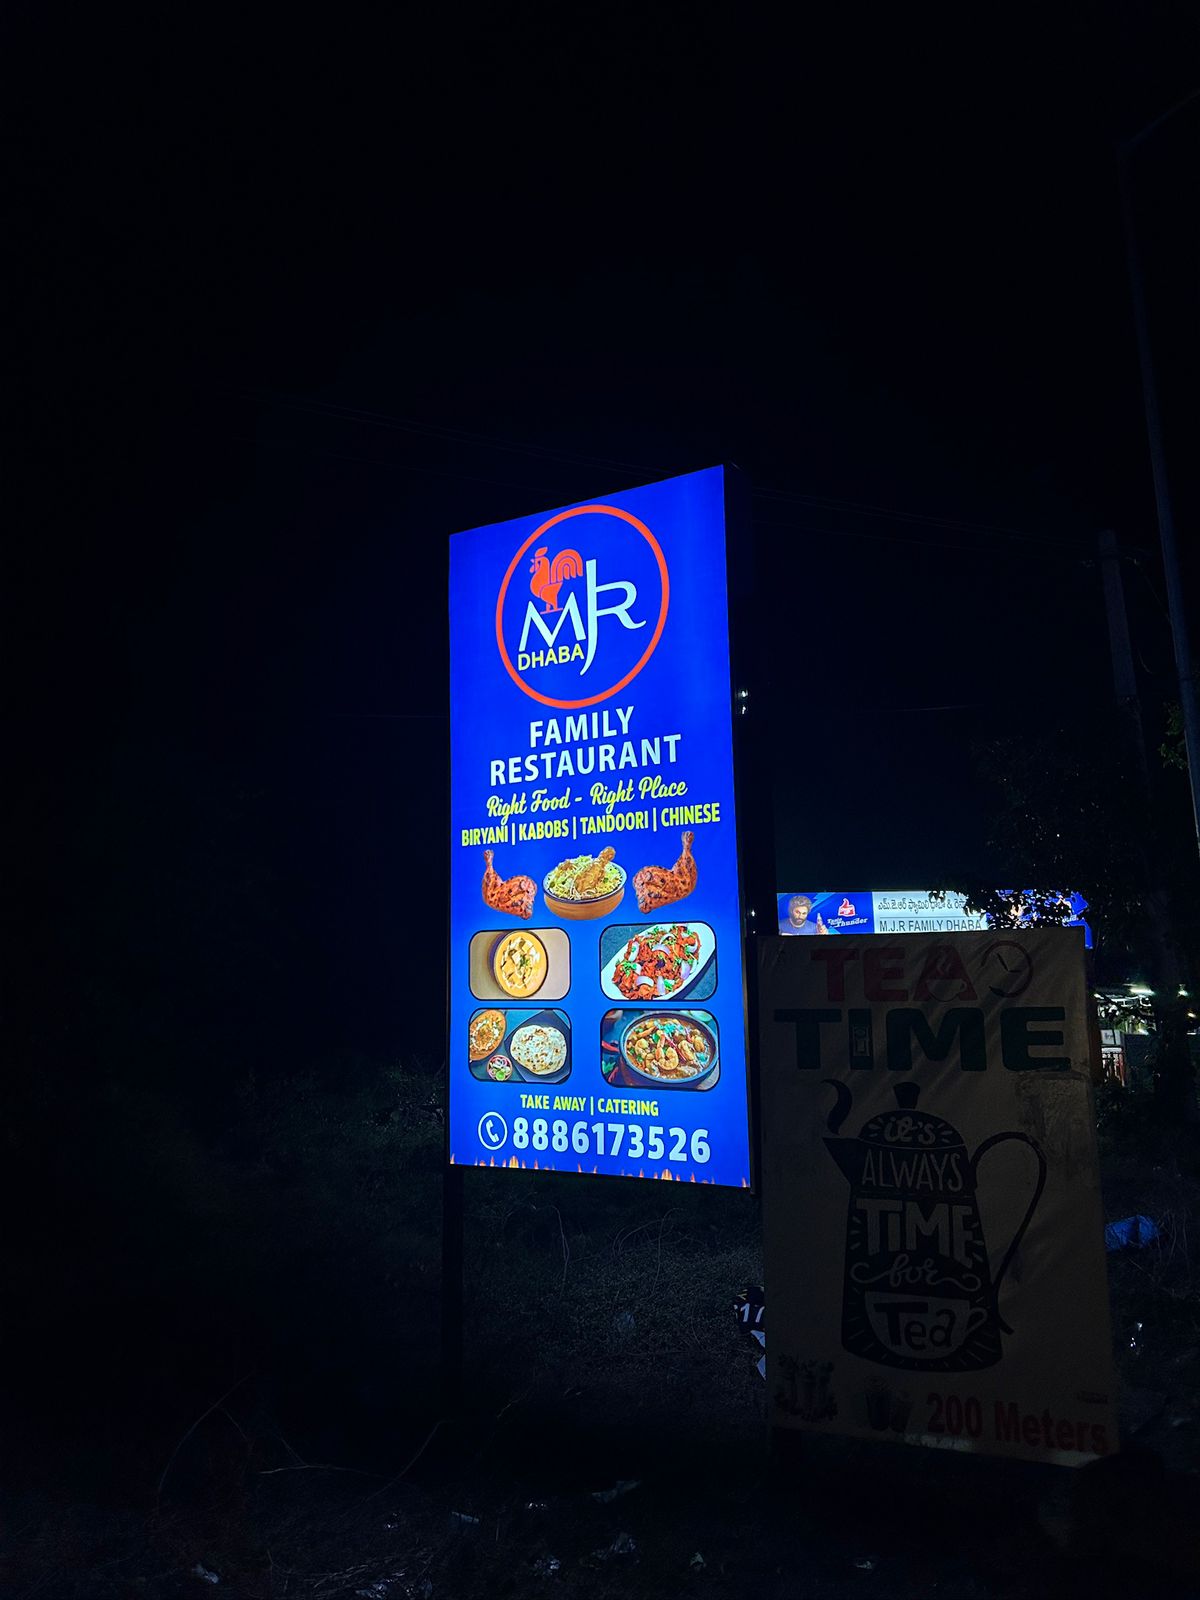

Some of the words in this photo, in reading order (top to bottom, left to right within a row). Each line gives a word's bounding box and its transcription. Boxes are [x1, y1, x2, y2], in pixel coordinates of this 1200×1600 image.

[517, 643, 585, 671] DHABA
[529, 705, 634, 748] FAMILY
[489, 734, 682, 787] RESTAURANT
[486, 793, 528, 826] Right
[530, 788, 571, 813] Food
[589, 780, 636, 815] Right
[637, 774, 688, 802] Place
[461, 827, 508, 847] BIRYANI
[518, 818, 569, 842] KABOBS
[580, 810, 649, 835] TANDOORI
[660, 802, 721, 828] CHINESE
[879, 921, 906, 932] M.J.R
[908, 920, 944, 931] FAMILY
[946, 919, 982, 931] DHABA
[811, 943, 977, 1003] TEA
[774, 1006, 1071, 1072] TIME
[520, 1094, 549, 1110] TAKE
[553, 1095, 586, 1112] AWAY
[597, 1098, 659, 1117] CATERING
[513, 1116, 711, 1164] 8886173526
[861, 1150, 963, 1192] ALWAYS
[875, 1301, 955, 1353] Tea
[926, 1392, 984, 1439] 200
[994, 1400, 1107, 1456] Meters
